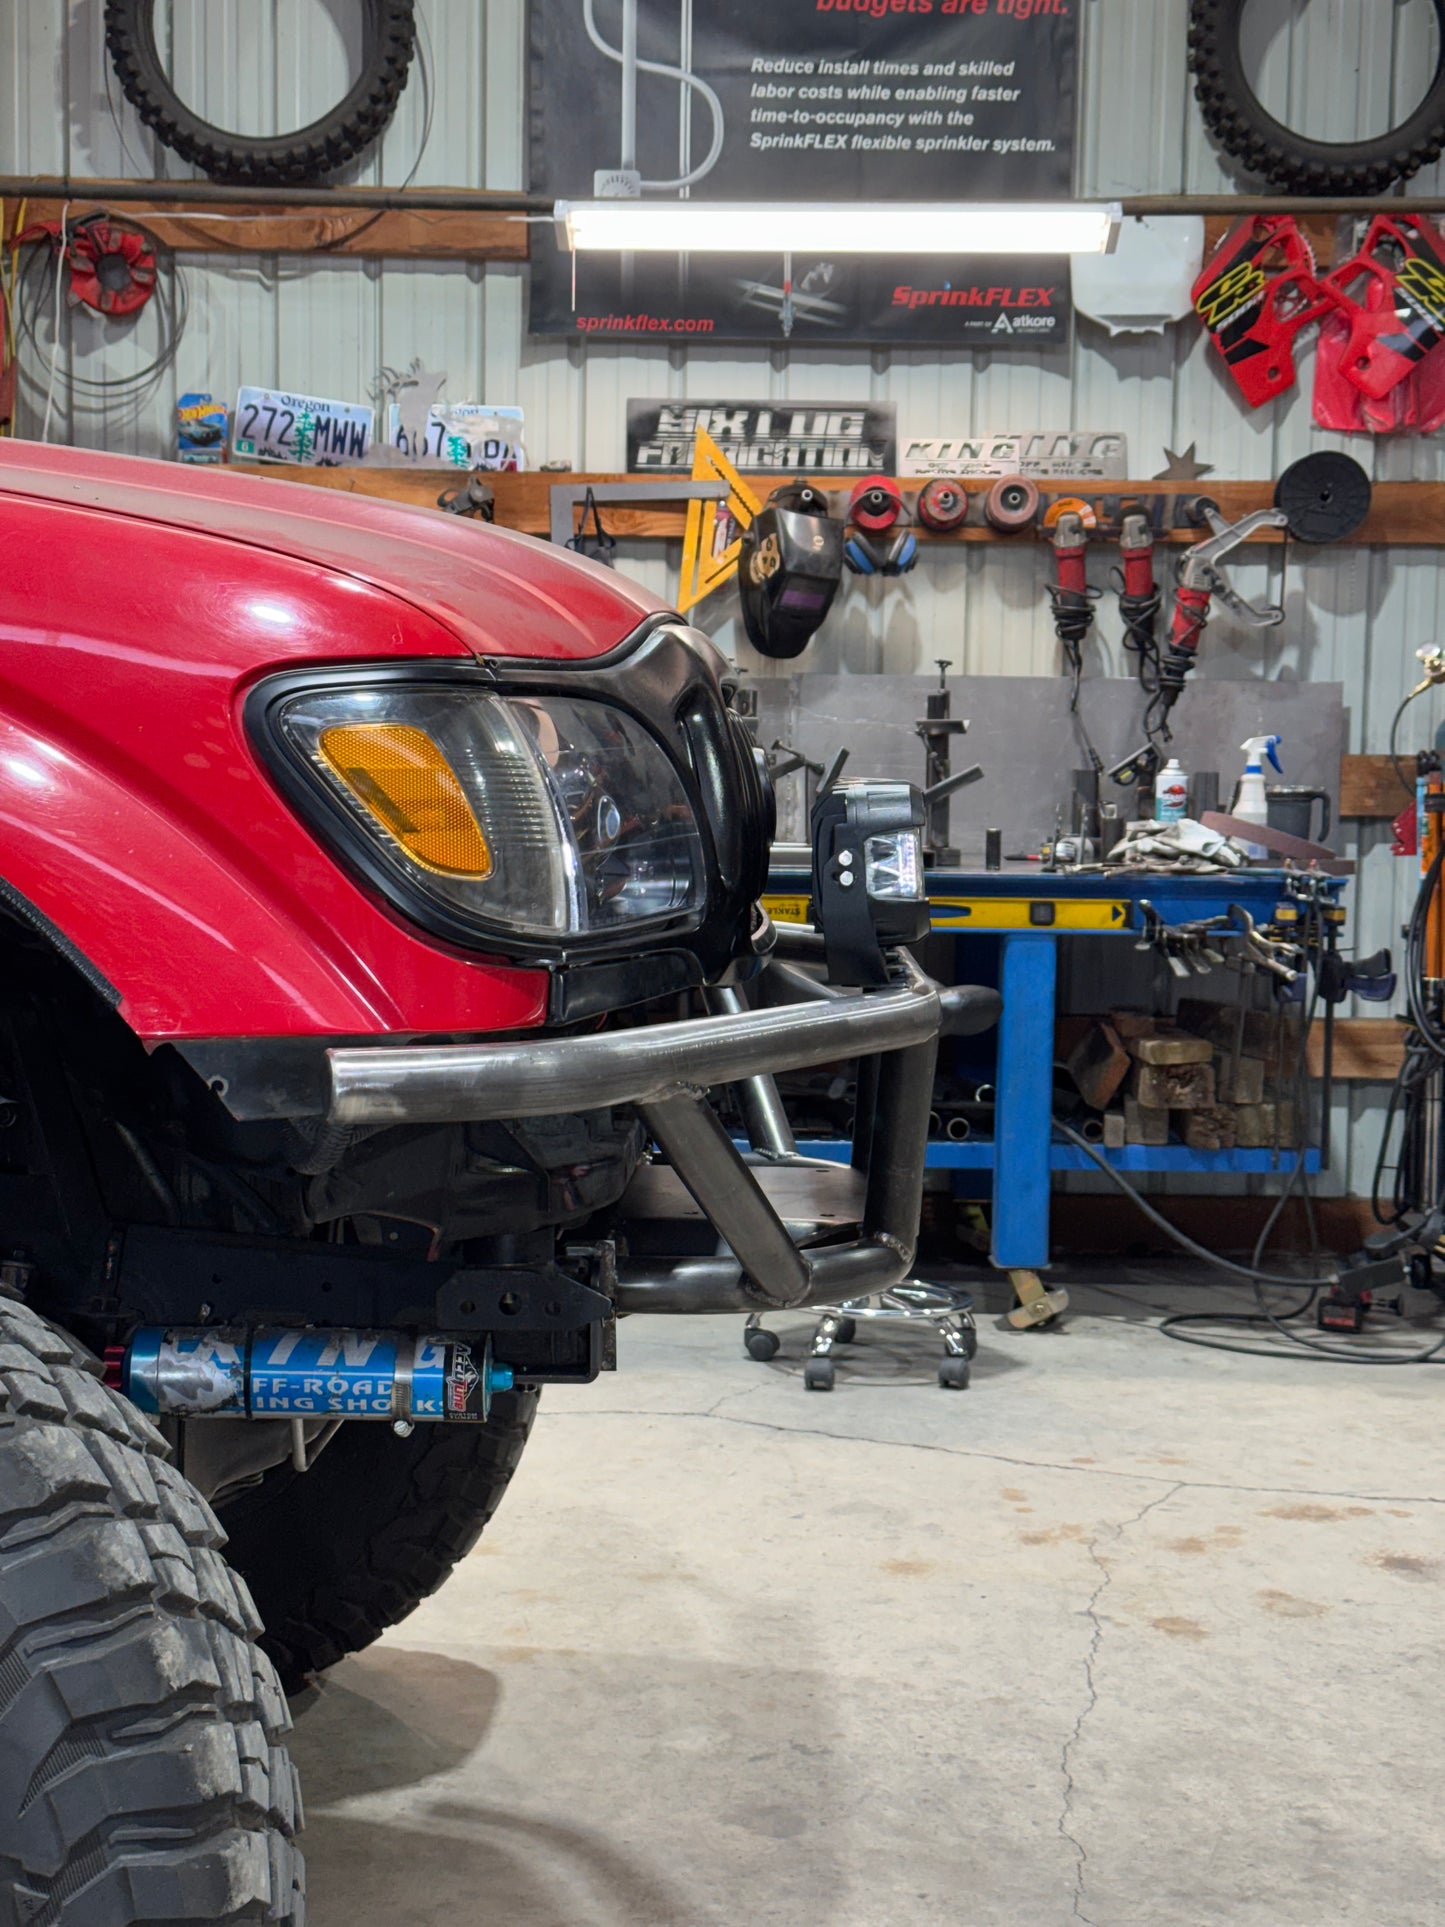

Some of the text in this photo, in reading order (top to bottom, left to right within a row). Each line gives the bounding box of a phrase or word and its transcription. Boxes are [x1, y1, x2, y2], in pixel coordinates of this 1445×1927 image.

[816, 0, 933, 17] budgets
[941, 0, 988, 14] are
[751, 58, 1015, 76] Reduce install times and skilled
[750, 83, 1021, 103] labor costs while enabling faster
[750, 109, 974, 127] time-to-occupancy with the
[750, 132, 1056, 154] SprinkFLEX flexible sprinkler system.
[891, 285, 1055, 310] SprinkFLEX
[576, 313, 714, 332] sprinkflex.com
[1012, 314, 1056, 328] atkore
[281, 395, 330, 412] Oregon
[241, 404, 367, 458] 272 MWW
[905, 443, 1015, 459] KING
[995, 435, 1121, 457] ING
[237, 1376, 394, 1395] FF-ROAD
